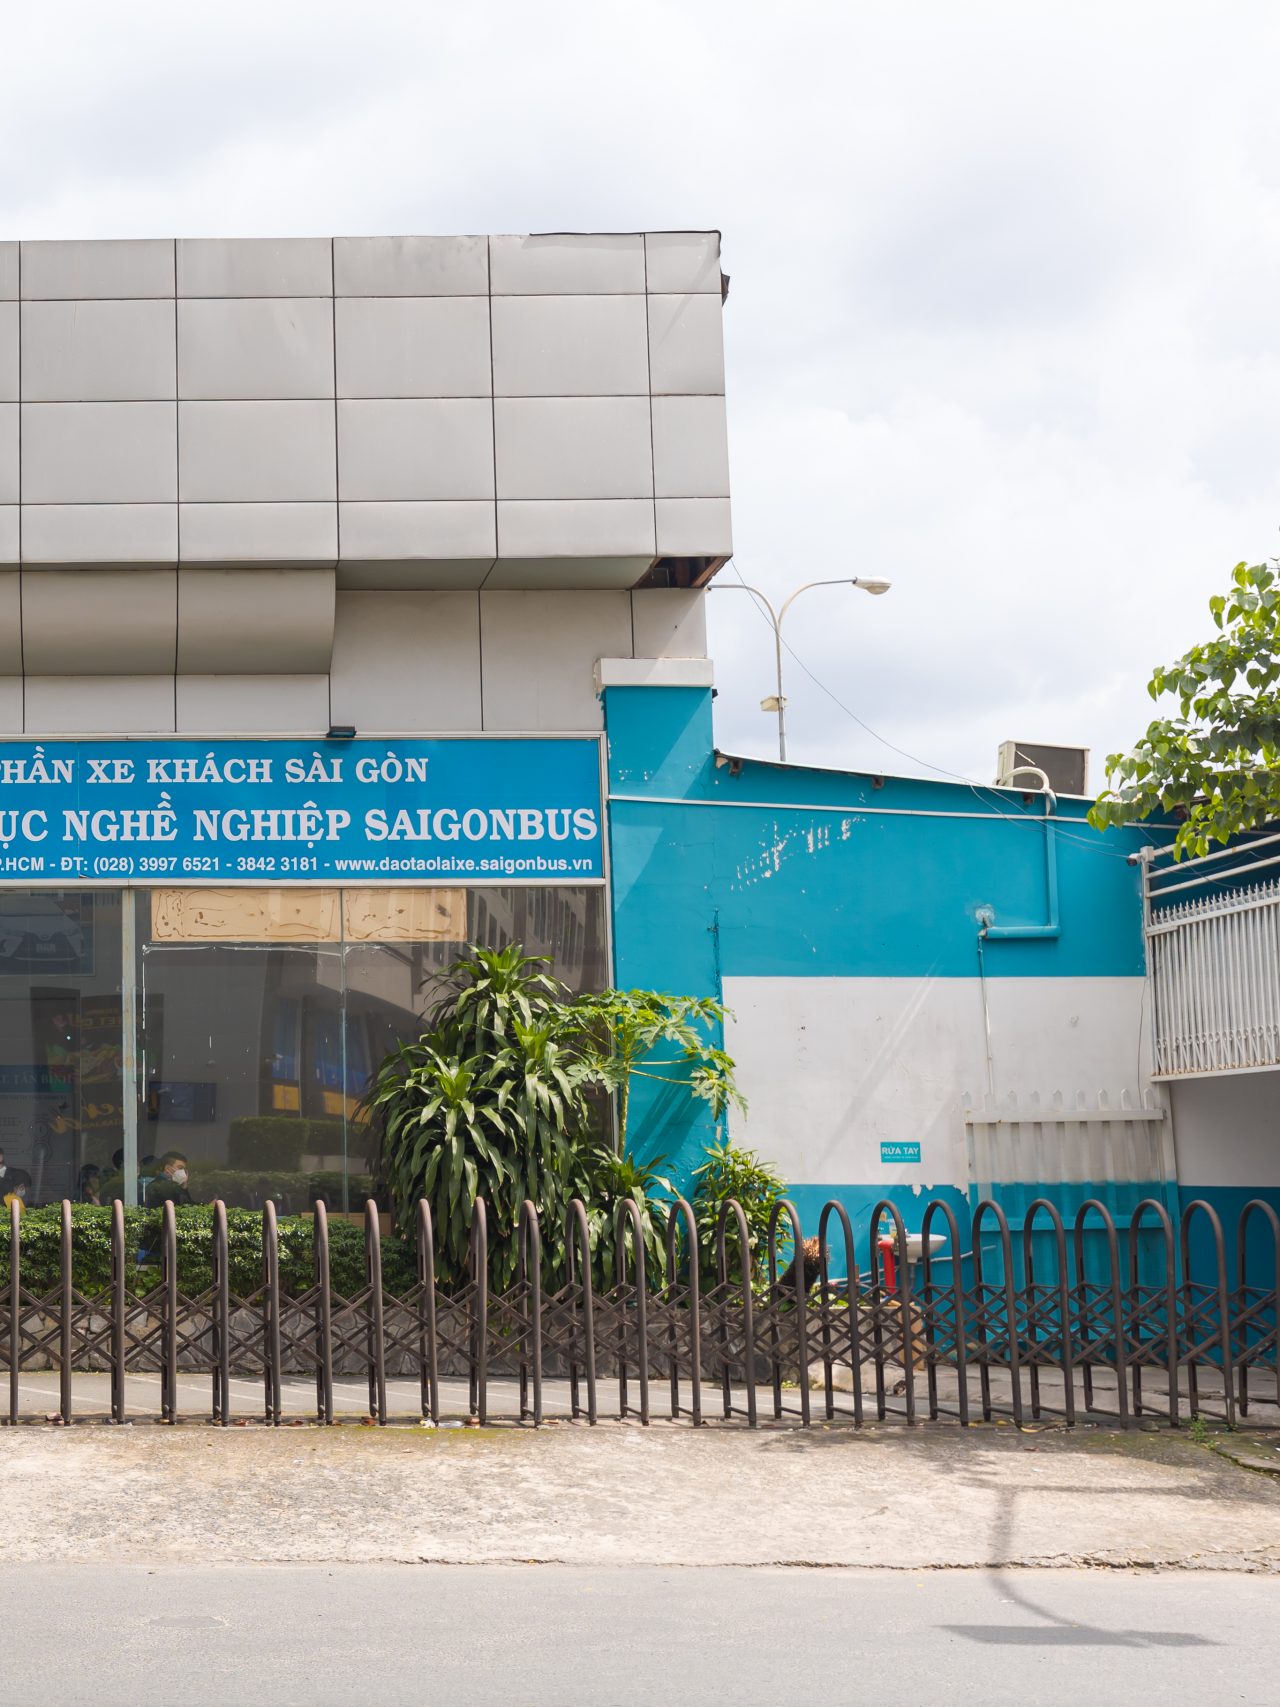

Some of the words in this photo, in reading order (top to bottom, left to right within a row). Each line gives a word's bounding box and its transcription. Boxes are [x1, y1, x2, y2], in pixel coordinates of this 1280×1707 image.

[86, 759, 135, 784] XE
[146, 752, 273, 784] KHÁCH
[285, 751, 343, 783] SÀI
[355, 751, 429, 783] GÒN
[62, 791, 178, 842] NGHỀ
[193, 800, 351, 850] NGHIỆP
[364, 808, 598, 841] SAIGONBUS
[60, 856, 88, 871] ĐT:
[93, 856, 135, 874] (028)
[139, 856, 178, 871] 3997
[182, 856, 220, 871] 6521
[237, 856, 276, 871] 3842
[280, 856, 317, 871] 3181
[334, 856, 593, 874] www.daotaolaixe.saigonbus.vn
[881, 1146, 902, 1155] RỬA
[903, 1147, 919, 1155] TAY
